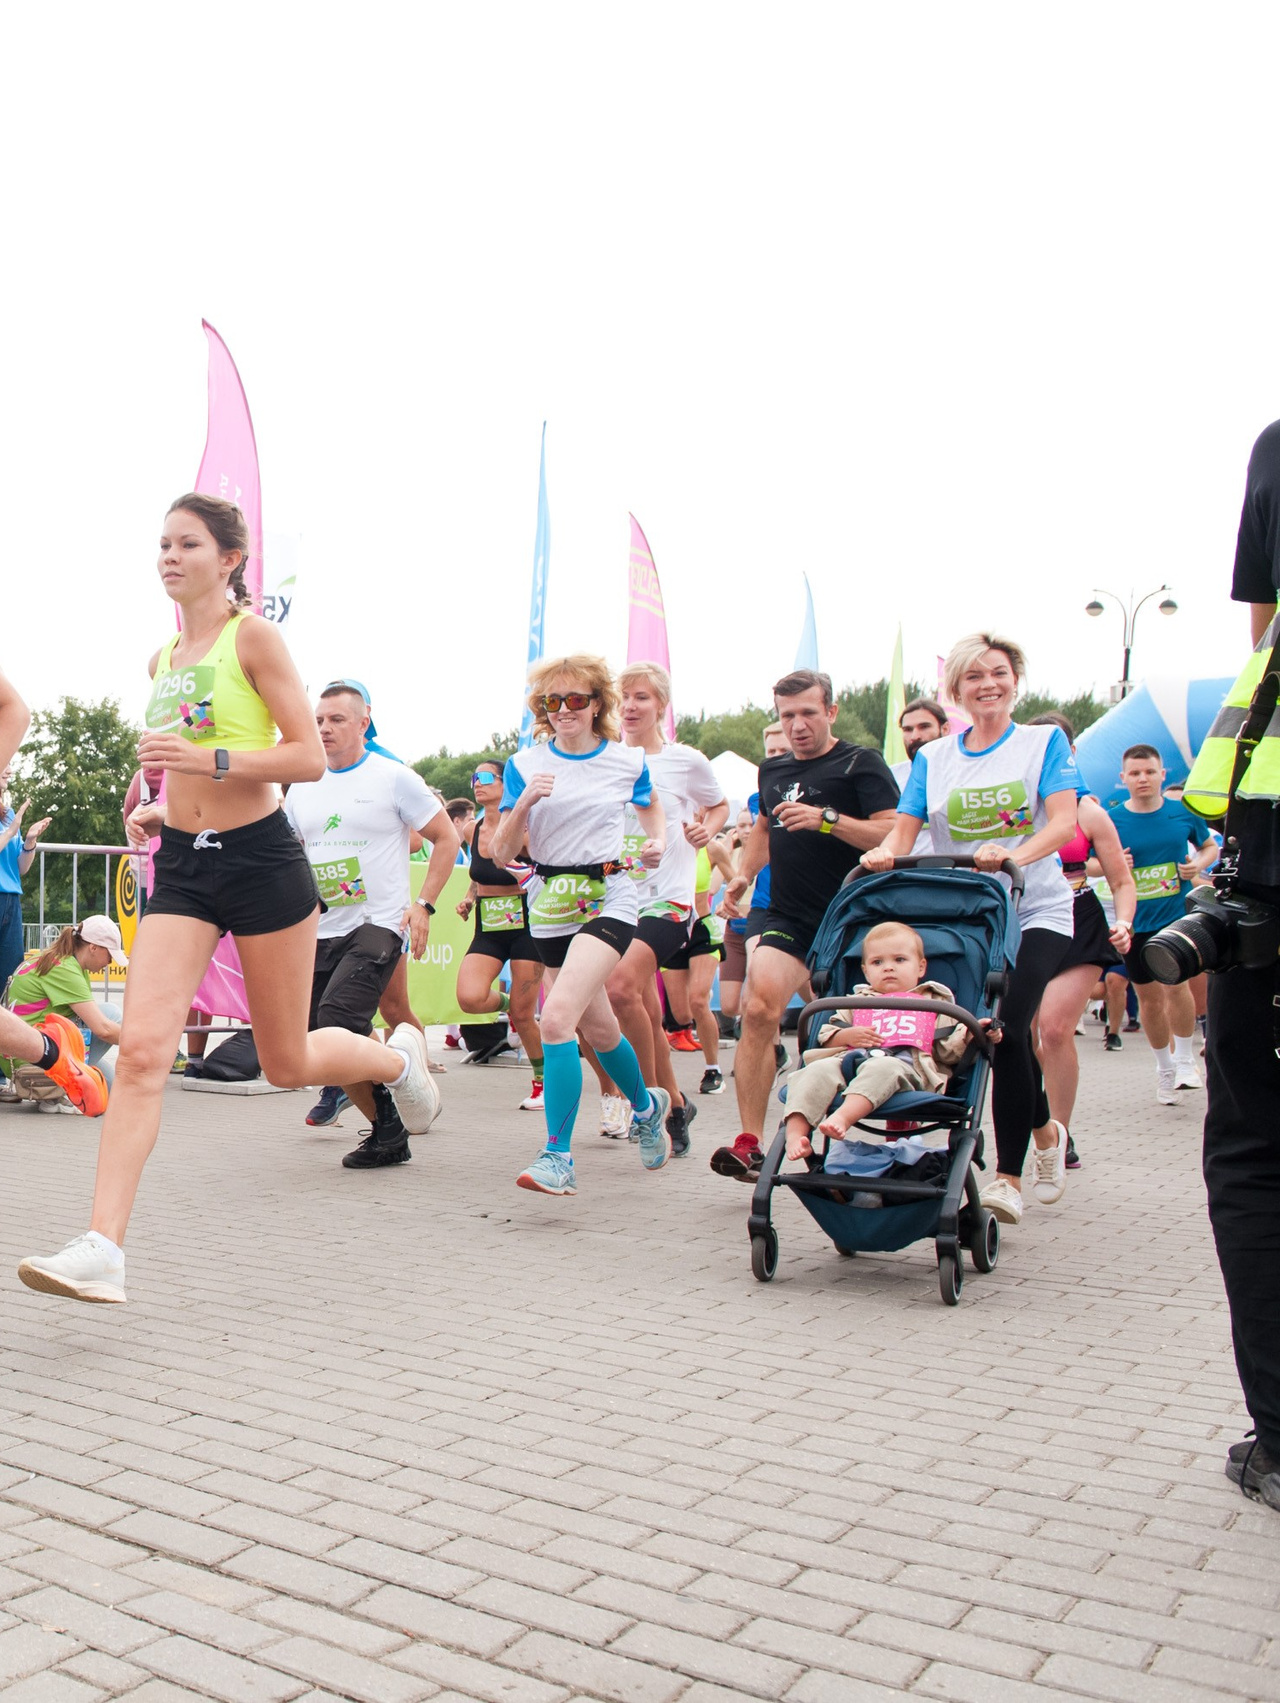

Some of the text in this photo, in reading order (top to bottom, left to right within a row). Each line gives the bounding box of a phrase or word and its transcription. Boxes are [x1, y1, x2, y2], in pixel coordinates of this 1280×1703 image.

[156, 672, 196, 699] 1296
[959, 787, 1012, 809] 1556
[313, 862, 349, 880] 1385
[1134, 866, 1169, 880] 1467
[548, 878, 592, 895] 1014
[484, 899, 515, 911] 1434
[871, 1015, 916, 1038] 135
